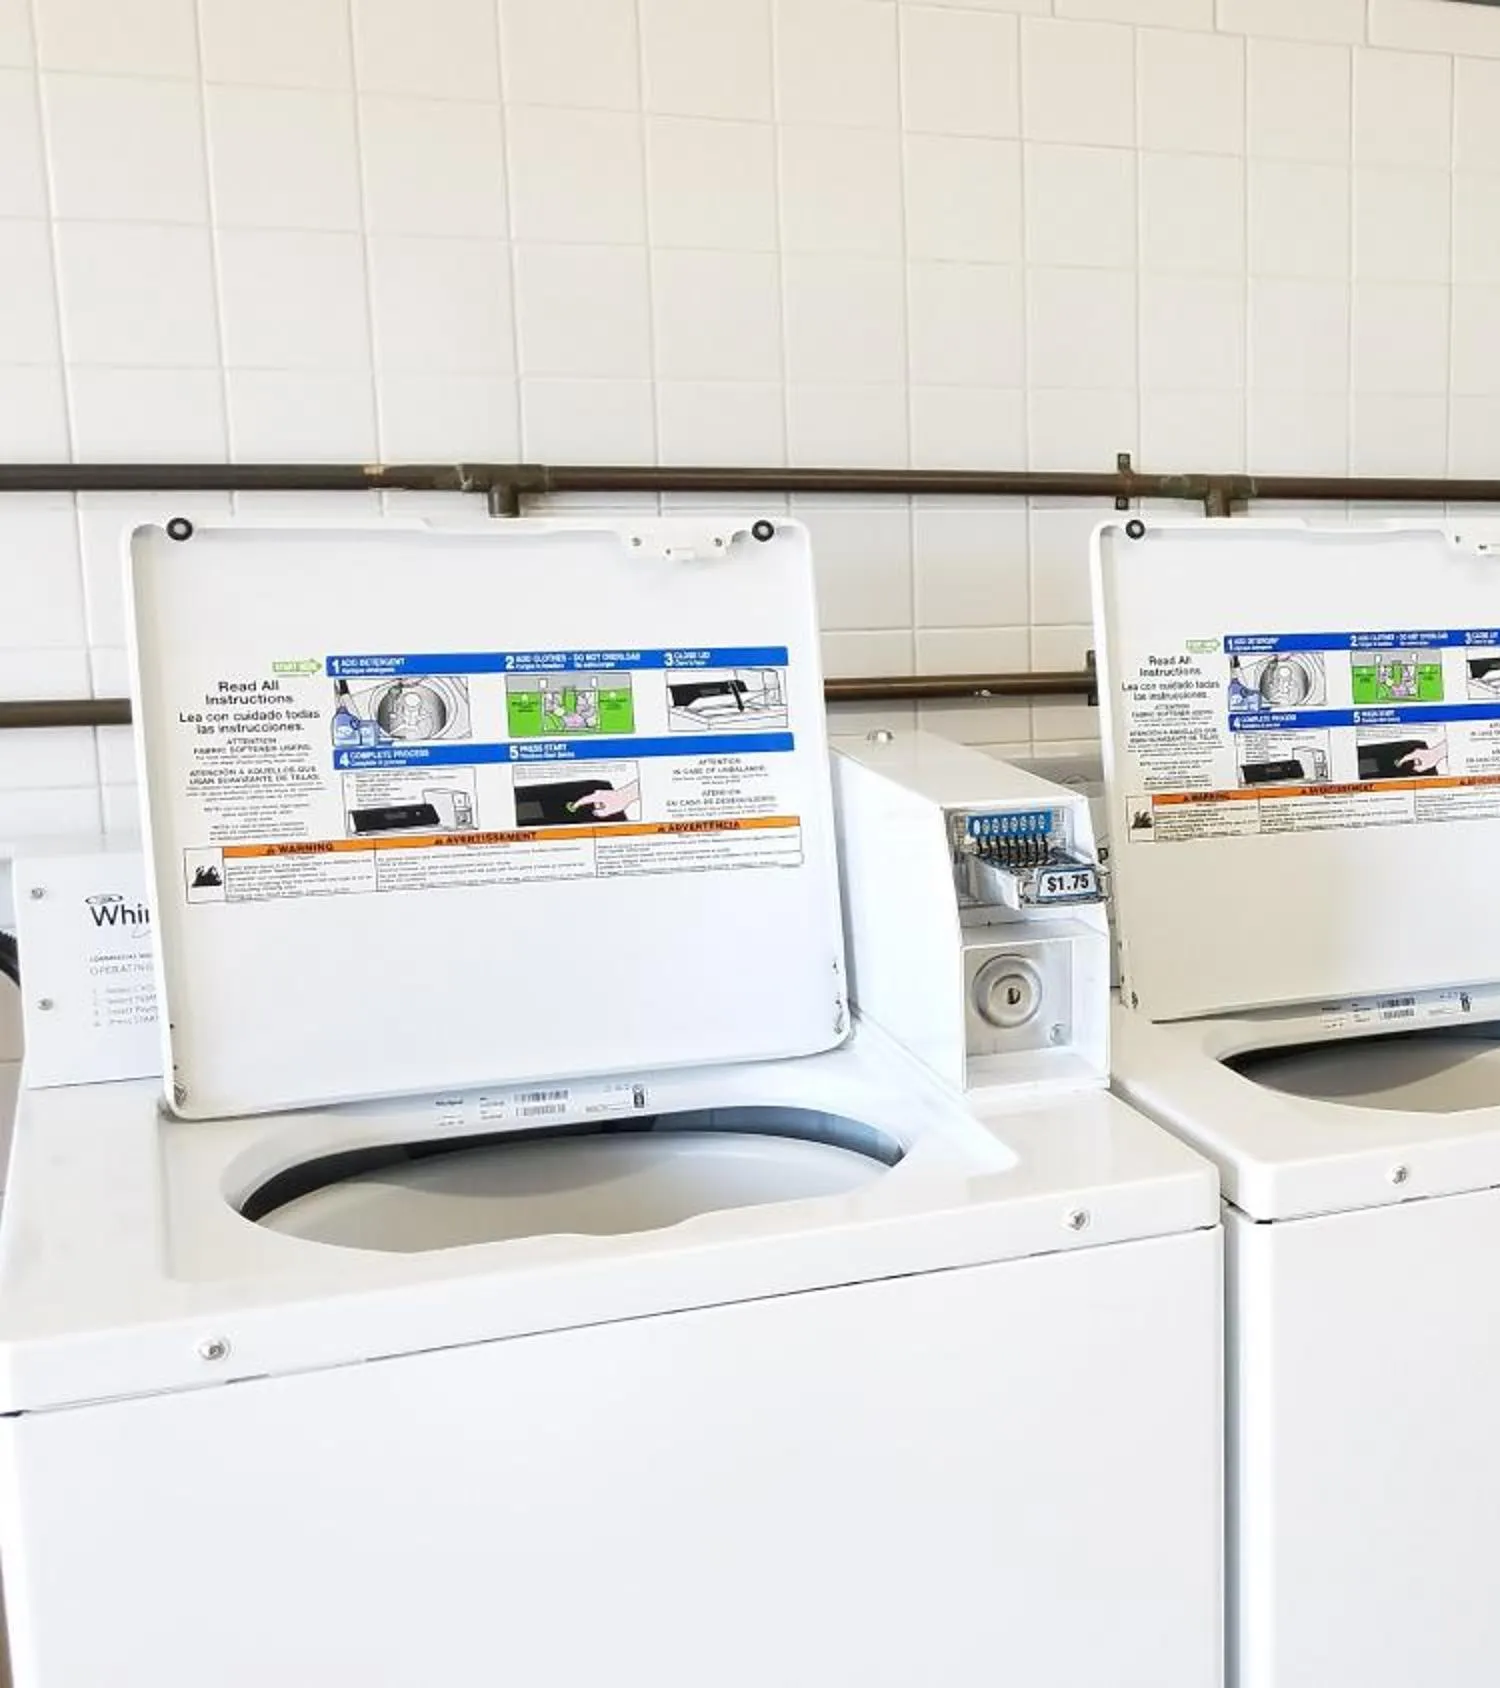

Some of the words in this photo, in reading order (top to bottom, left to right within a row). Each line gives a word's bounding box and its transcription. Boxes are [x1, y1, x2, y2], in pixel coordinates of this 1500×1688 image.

[1351, 635, 1358, 646] 2
[506, 656, 514, 670] 2
[664, 652, 673, 666] 3
[1149, 656, 1176, 664] Read
[1178, 656, 1192, 664] All
[332, 659, 339, 674] 1
[341, 659, 358, 667] ADD
[218, 680, 257, 692] Read
[261, 680, 280, 691] All
[1122, 682, 1138, 691] Lea
[205, 693, 294, 705] Instructions
[179, 712, 202, 723] Lea
[206, 712, 229, 721] con
[234, 710, 282, 721] cuidado
[286, 709, 320, 719] todas
[1353, 712, 1360, 722] 5
[197, 724, 215, 734] las
[509, 745, 519, 759] 5
[339, 752, 349, 767] 4
[446, 831, 537, 845] AVERTISSEMENT
[280, 843, 334, 853] WARNING
[1047, 874, 1089, 893] $1.75
